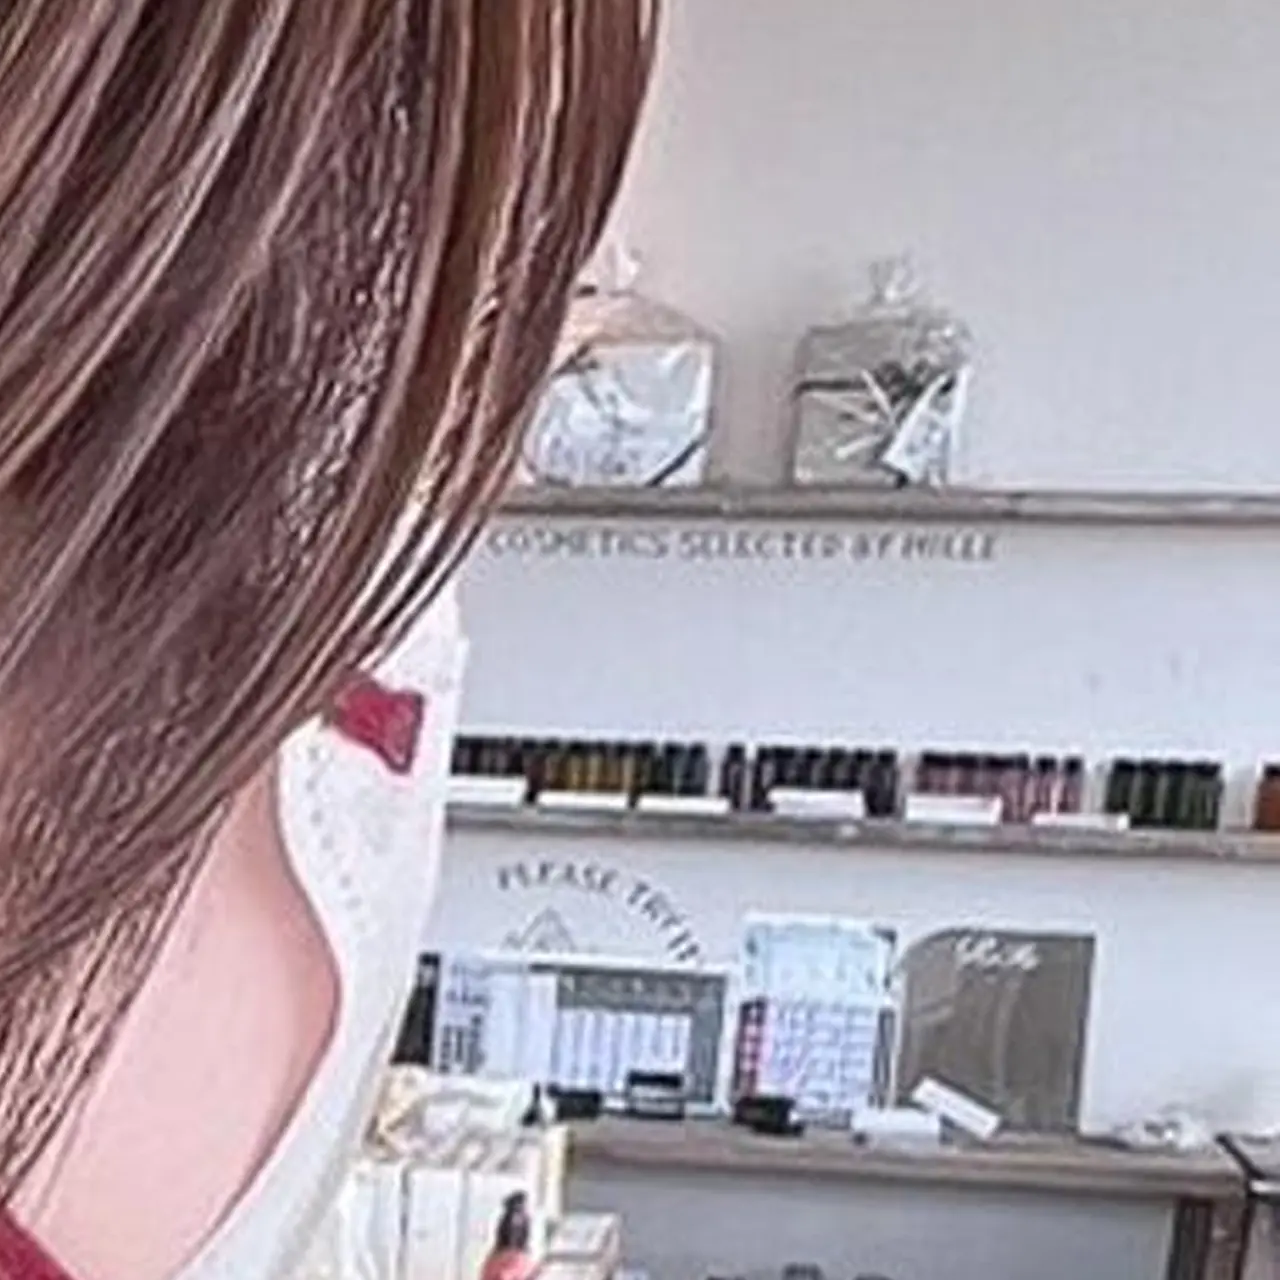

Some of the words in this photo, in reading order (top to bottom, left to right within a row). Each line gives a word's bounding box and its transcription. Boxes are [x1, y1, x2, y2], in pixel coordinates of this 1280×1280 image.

[678, 530, 840, 561] SELECTED
[850, 531, 892, 561] BY
[497, 862, 619, 893] PLEASE
[626, 880, 687, 932] TRY
